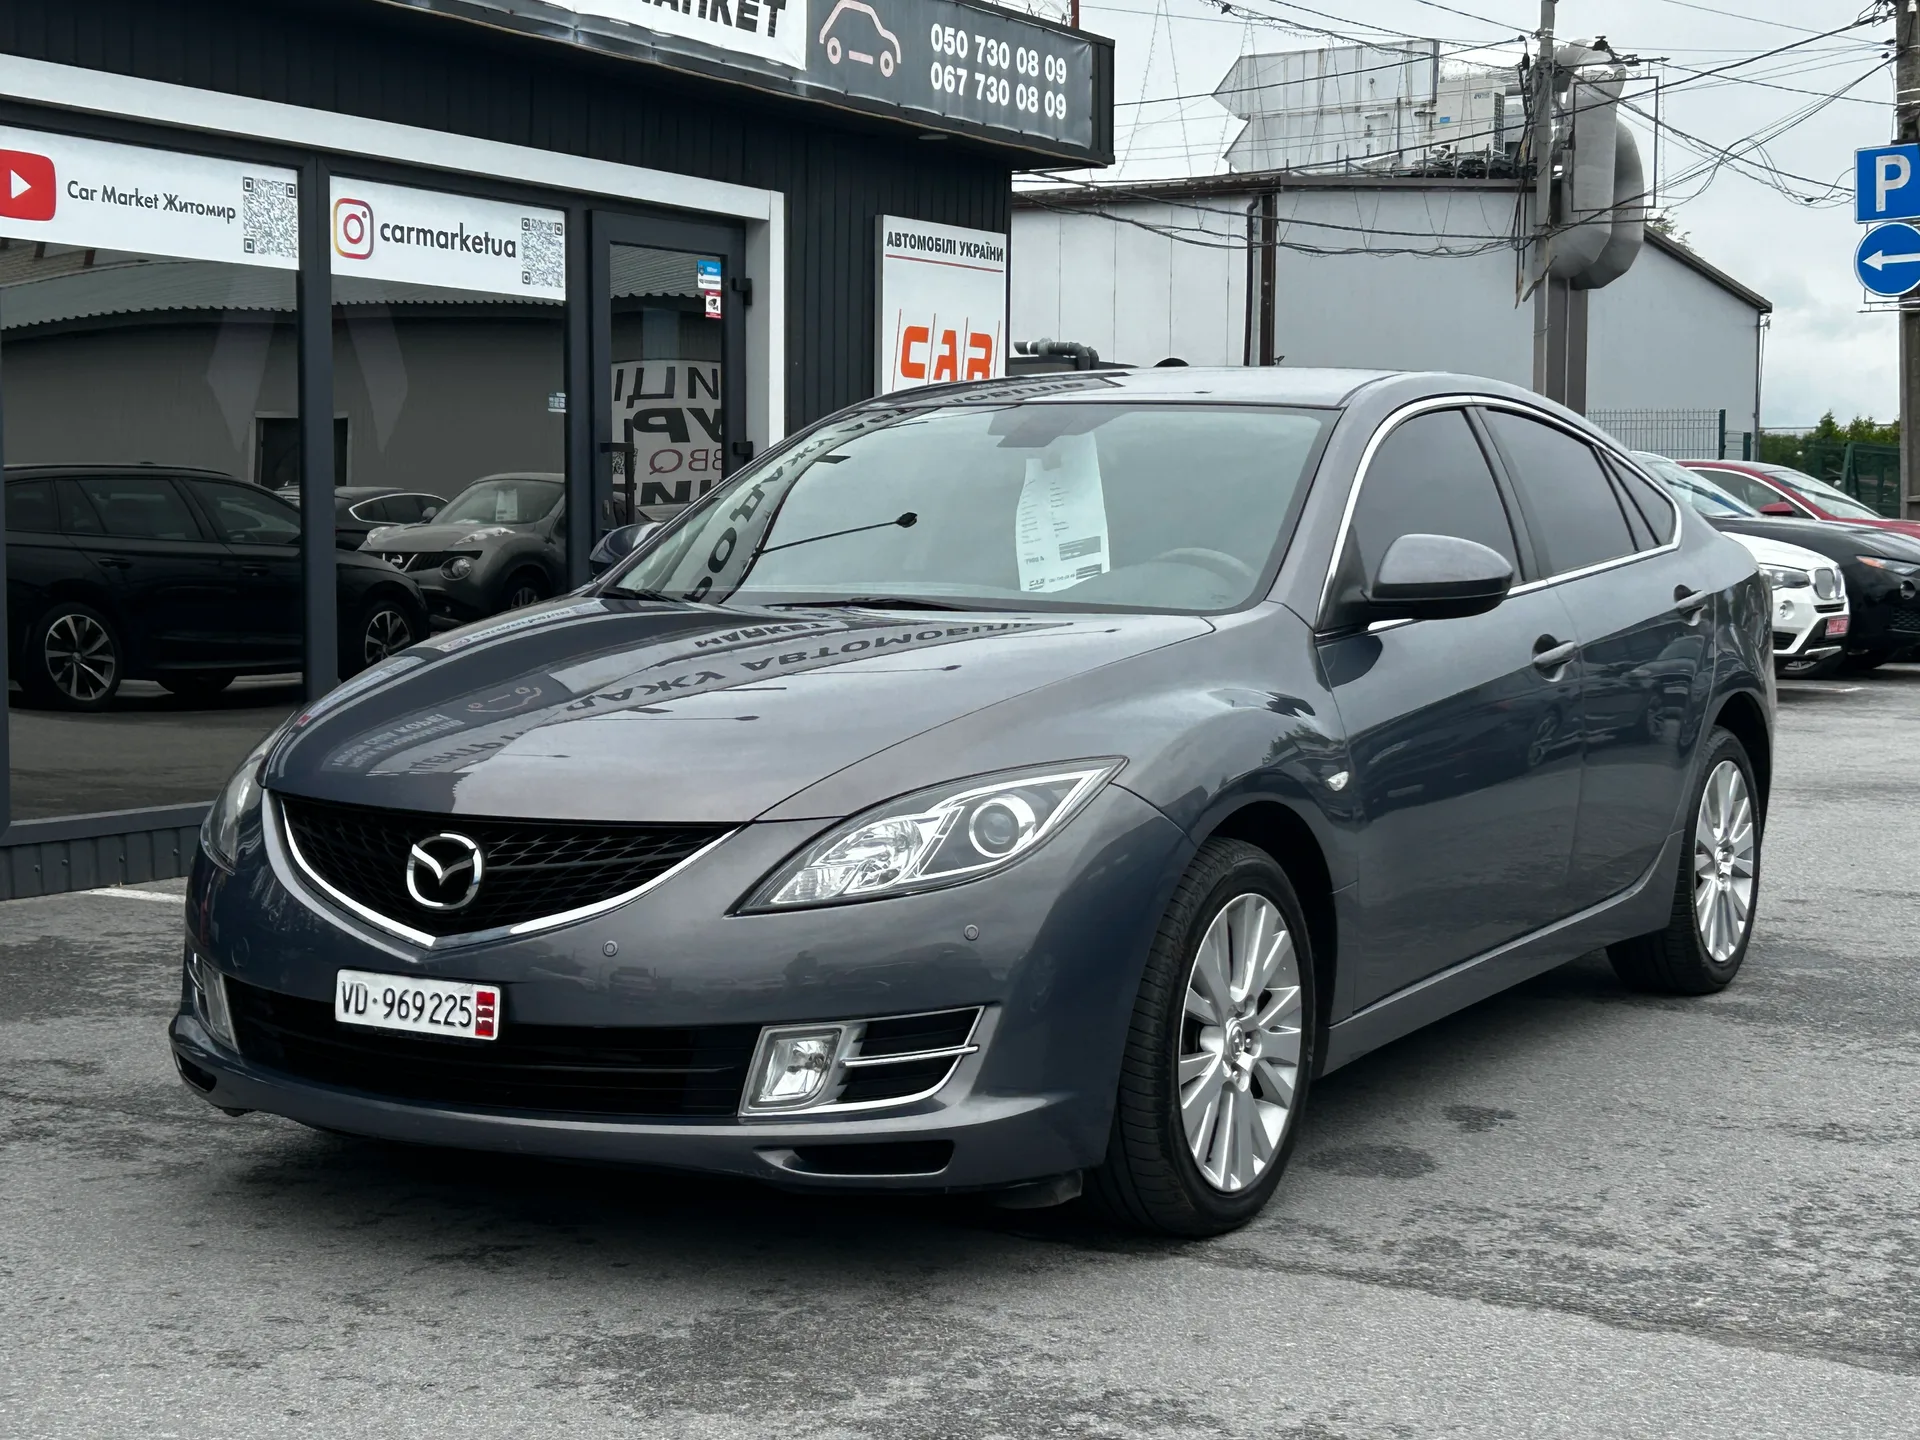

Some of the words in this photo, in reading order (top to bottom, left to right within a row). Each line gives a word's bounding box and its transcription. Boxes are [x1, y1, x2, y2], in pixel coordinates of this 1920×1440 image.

[930, 23, 968, 59] 050
[975, 35, 1010, 69] 730
[1016, 47, 1039, 77] 08
[1045, 55, 1067, 84] 09
[930, 61, 968, 96] 067
[975, 72, 1010, 106] 730
[1016, 83, 1039, 113] 08
[1044, 90, 1067, 120] 09
[67, 180, 97, 201] Car
[101, 184, 159, 210] Market
[162, 193, 236, 224] Житомир
[1875, 154, 1911, 212] P
[380, 222, 517, 258] carmarketua
[886, 231, 957, 256] АВТОМОБІЛІ
[959, 241, 1004, 263] УКРАЇНИ
[900, 325, 993, 382] CAR
